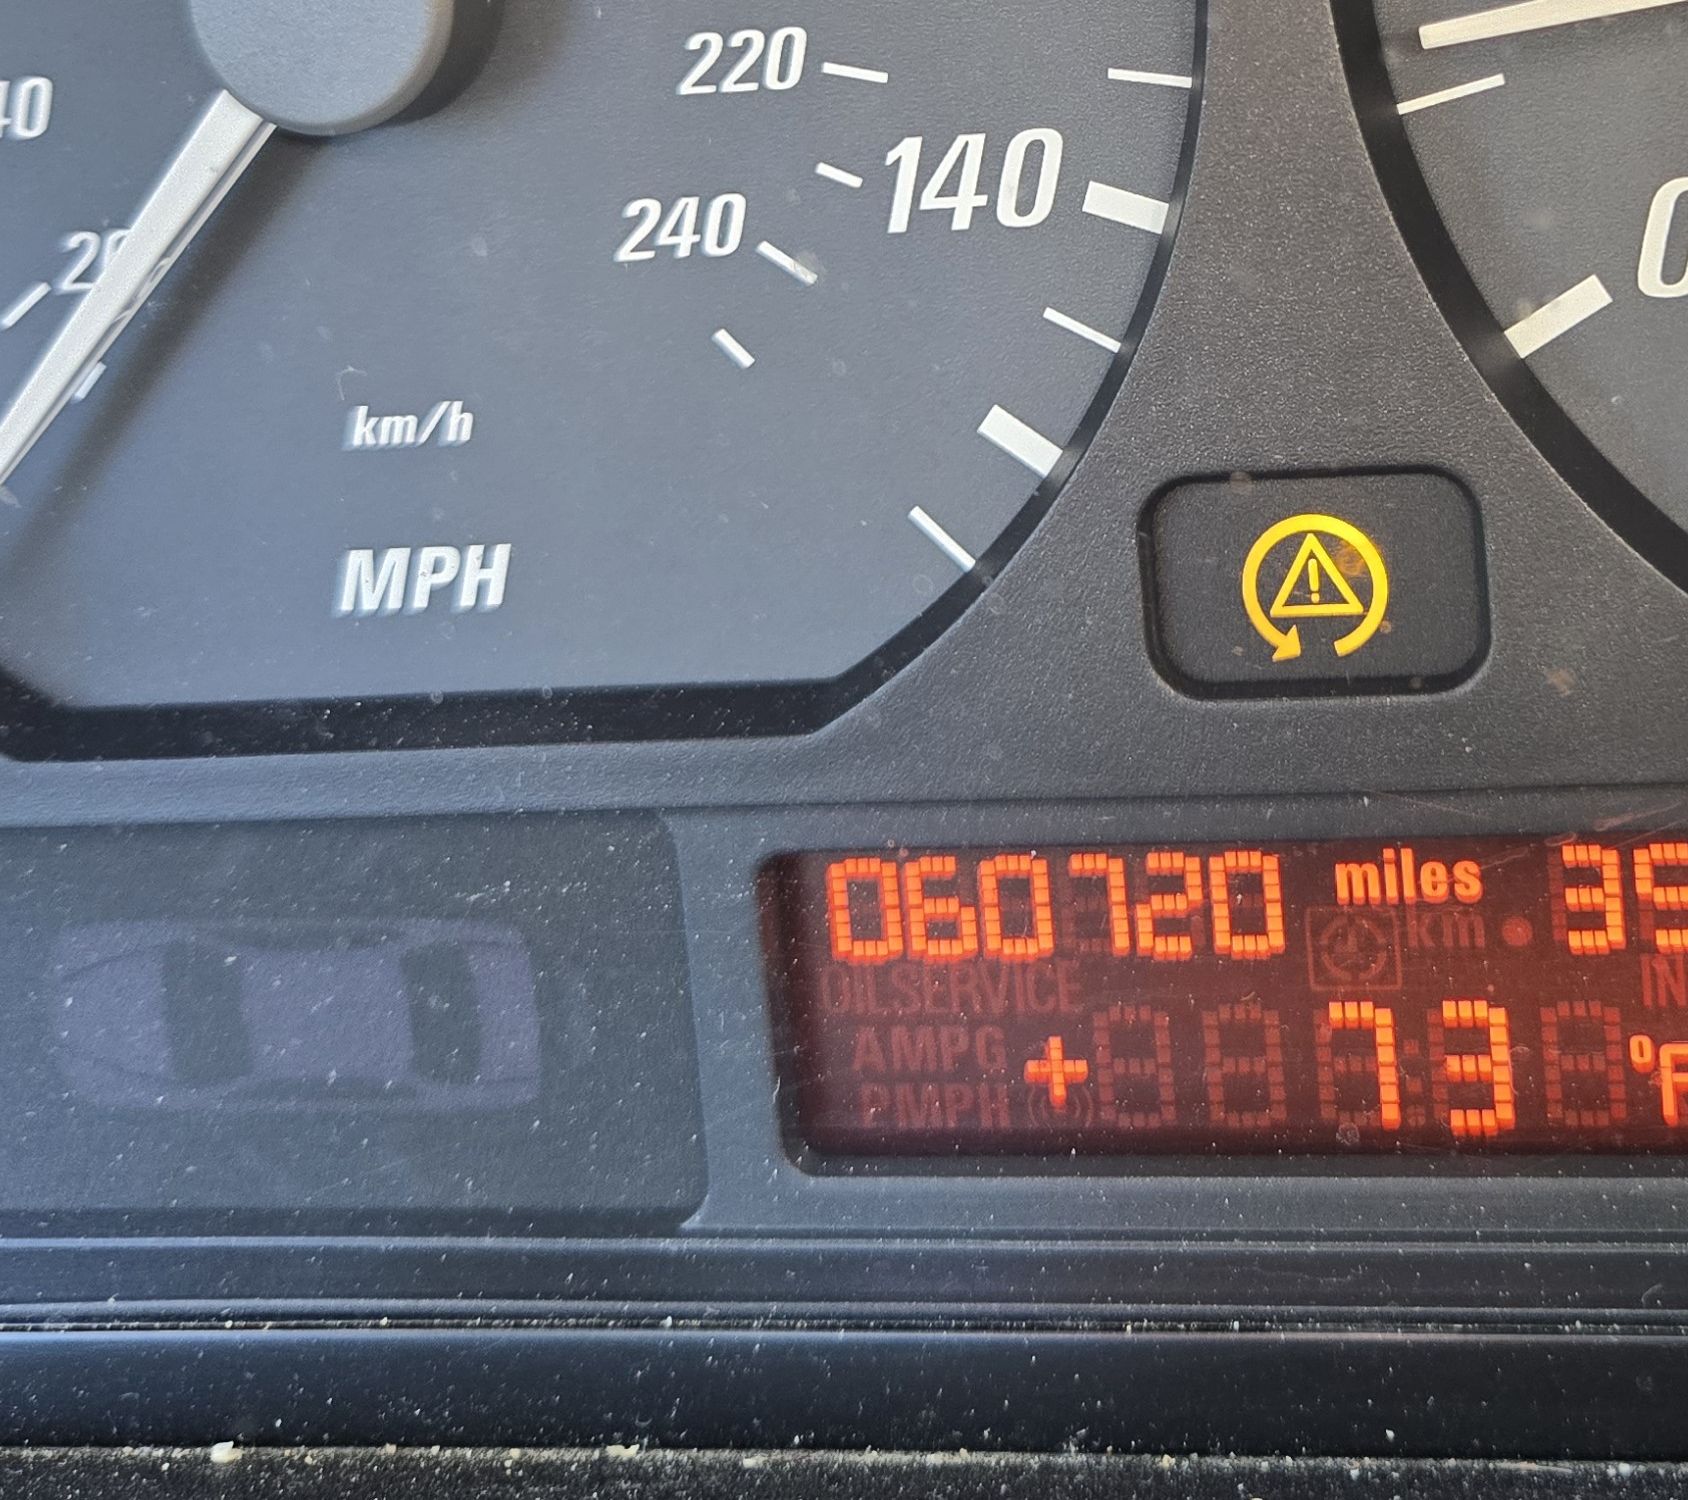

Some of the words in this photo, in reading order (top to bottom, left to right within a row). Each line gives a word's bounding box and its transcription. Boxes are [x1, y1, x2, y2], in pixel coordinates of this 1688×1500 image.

[678, 26, 807, 95] 220
[885, 127, 1063, 234] 140
[615, 193, 746, 262] 240
[350, 401, 473, 447] km/h
[338, 543, 511, 613] MPH
[827, 851, 1286, 963] 060720
[1335, 847, 1483, 905] miles
